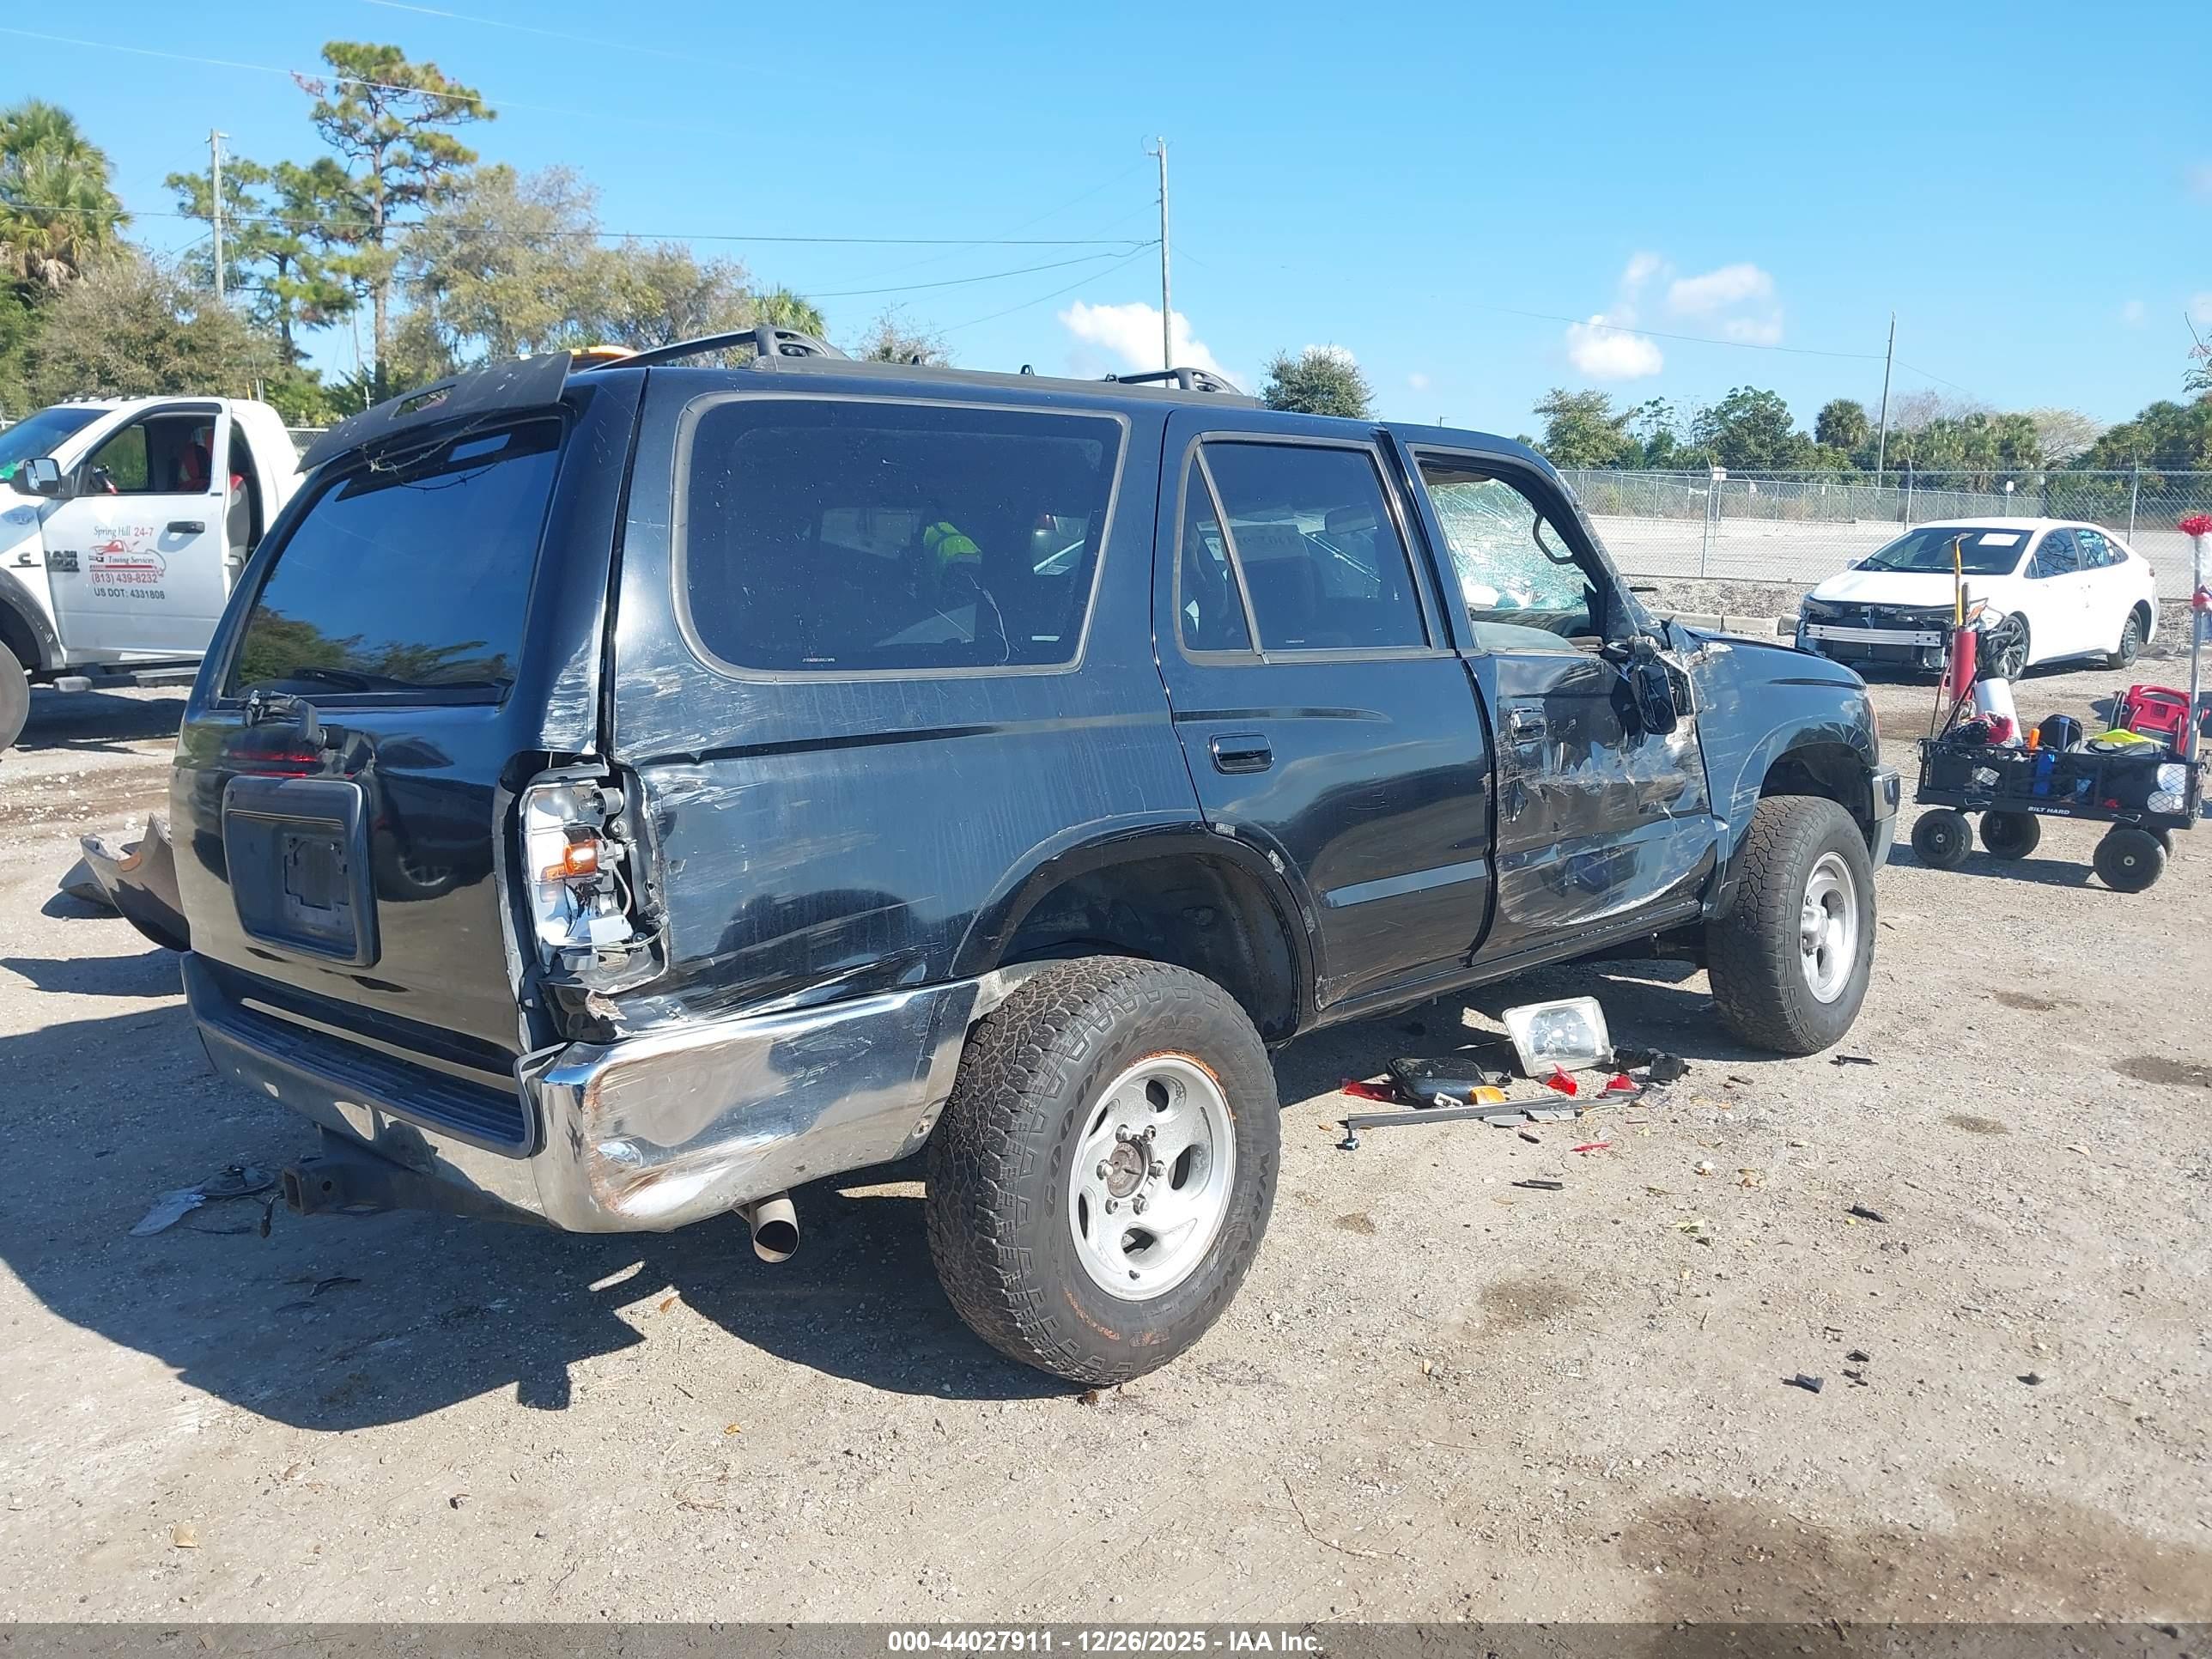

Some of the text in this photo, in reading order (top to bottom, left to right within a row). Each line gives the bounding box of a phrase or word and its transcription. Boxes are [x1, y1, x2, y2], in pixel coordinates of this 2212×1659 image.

[94, 526, 155, 538] Spring Hill 24-7
[108, 556, 129, 564] Towing
[92, 572, 158, 585] (813) 439-8232
[94, 587, 106, 597] US
[107, 588, 129, 598] DOT:
